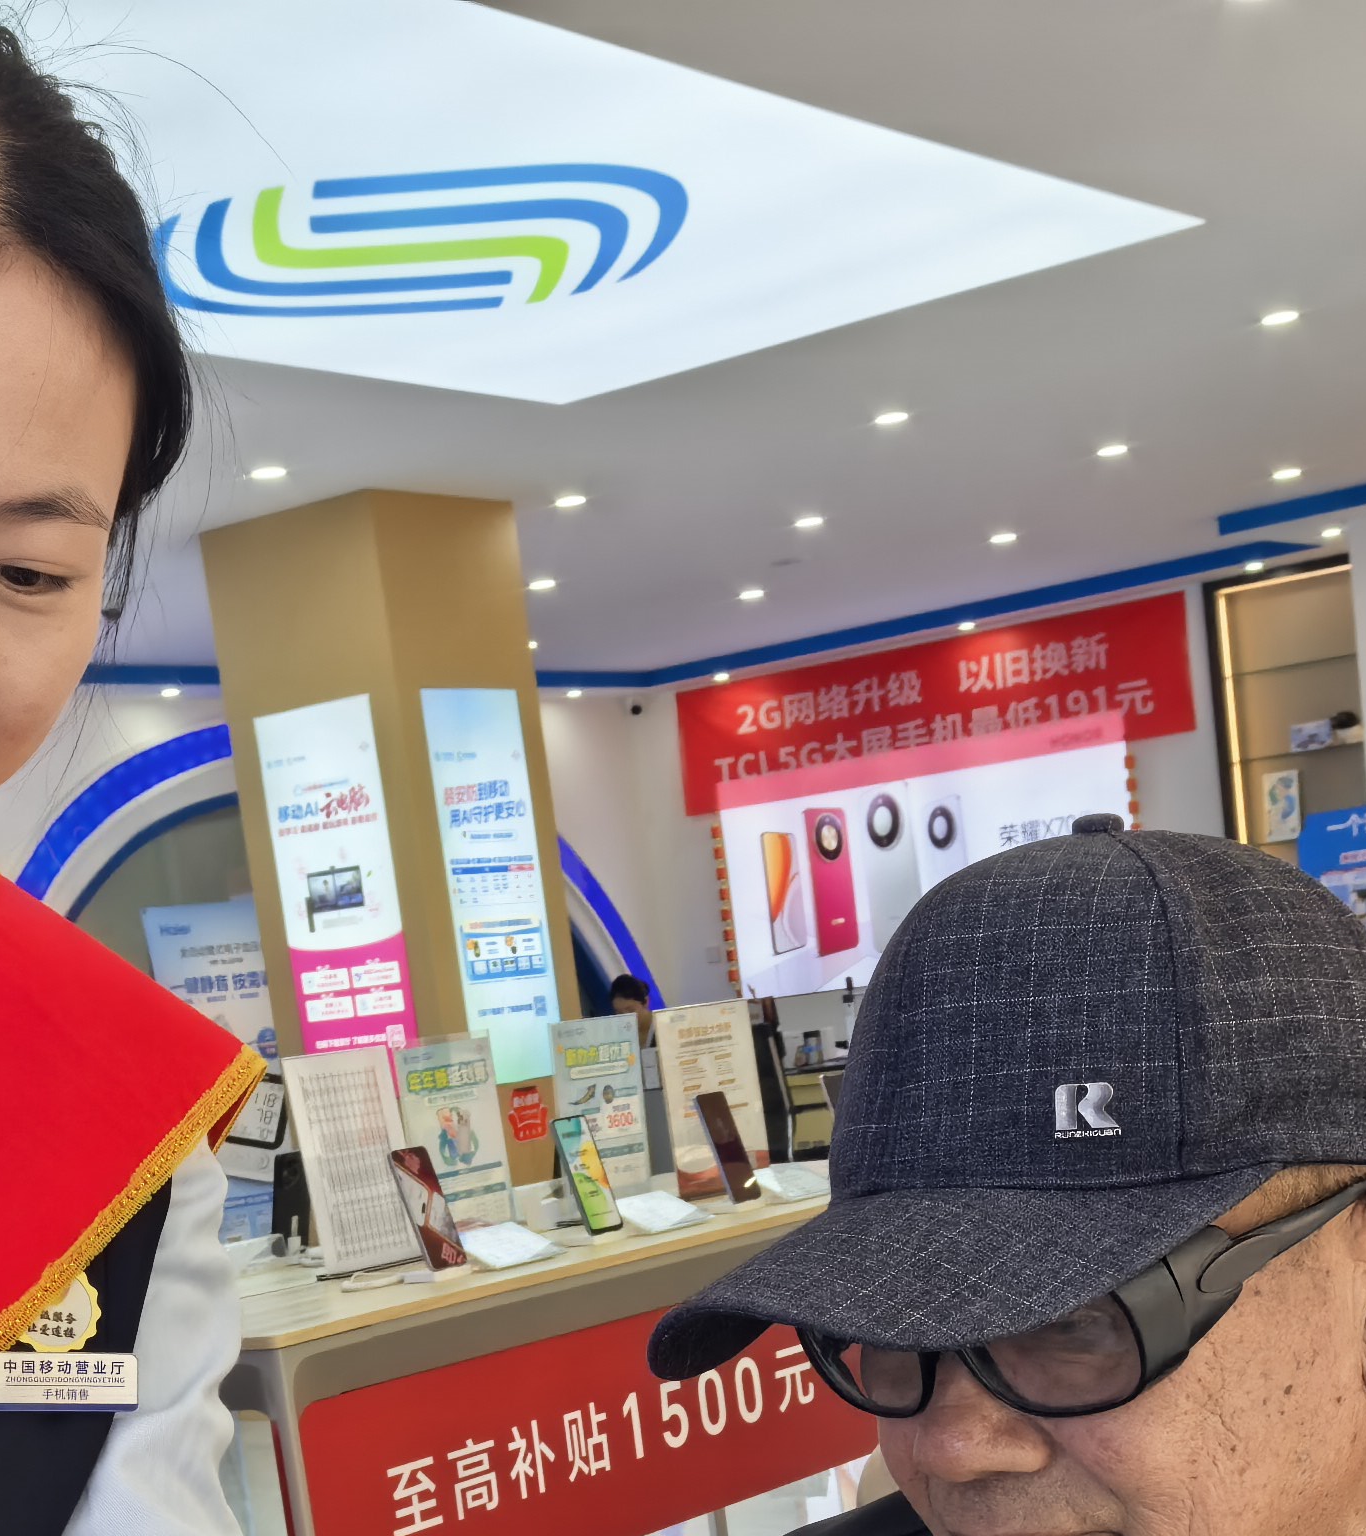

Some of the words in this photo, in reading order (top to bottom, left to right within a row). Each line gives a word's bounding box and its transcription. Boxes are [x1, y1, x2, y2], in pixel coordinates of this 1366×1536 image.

[736, 670, 922, 735] 2G网络升级
[957, 633, 1109, 693] 以旧换新
[3, 1359, 125, 1375] 中国移动营业厅
[42, 1388, 90, 1401] 手机销售
